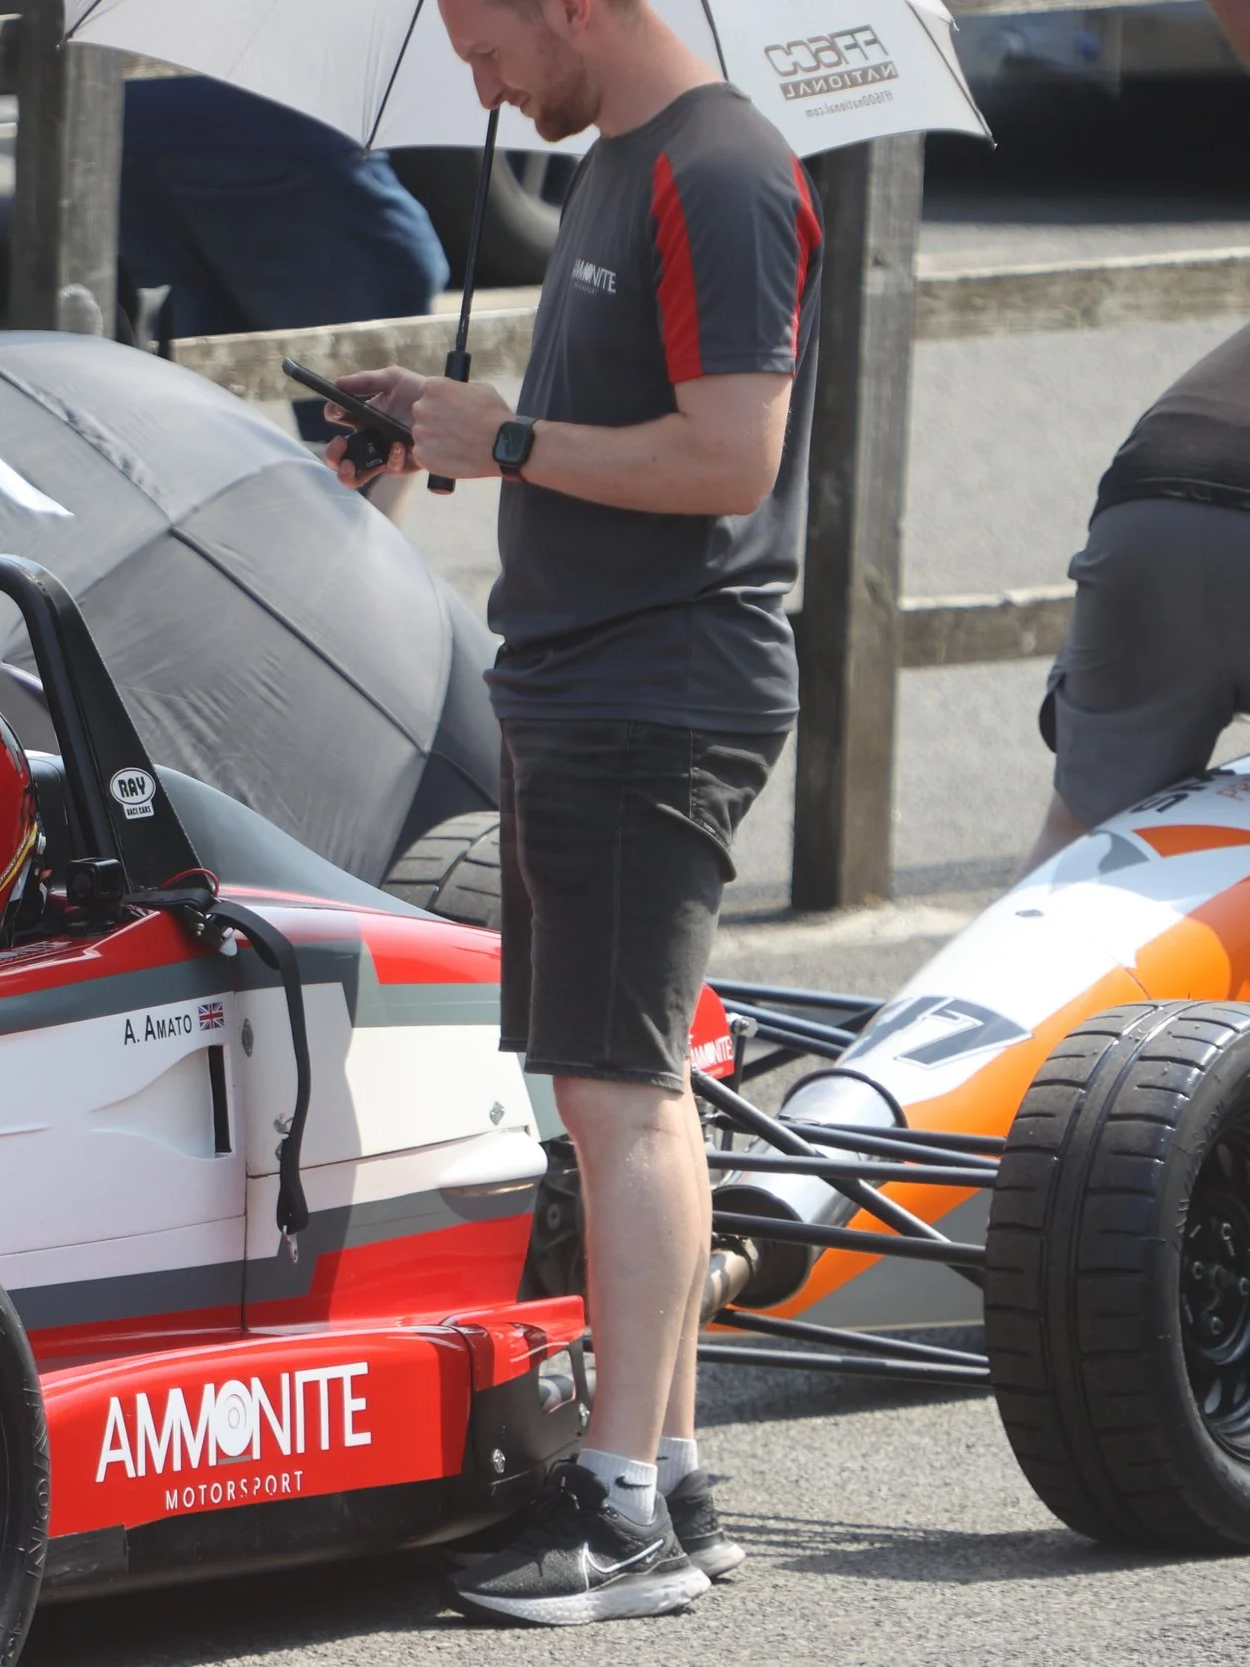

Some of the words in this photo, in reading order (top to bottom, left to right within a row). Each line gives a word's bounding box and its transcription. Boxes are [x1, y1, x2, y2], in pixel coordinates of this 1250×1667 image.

[118, 776, 146, 798] RAY
[124, 1018, 140, 1045] A.
[95, 1361, 372, 1483] AMMONITE
[165, 1470, 303, 1511] MOTORSPORT
